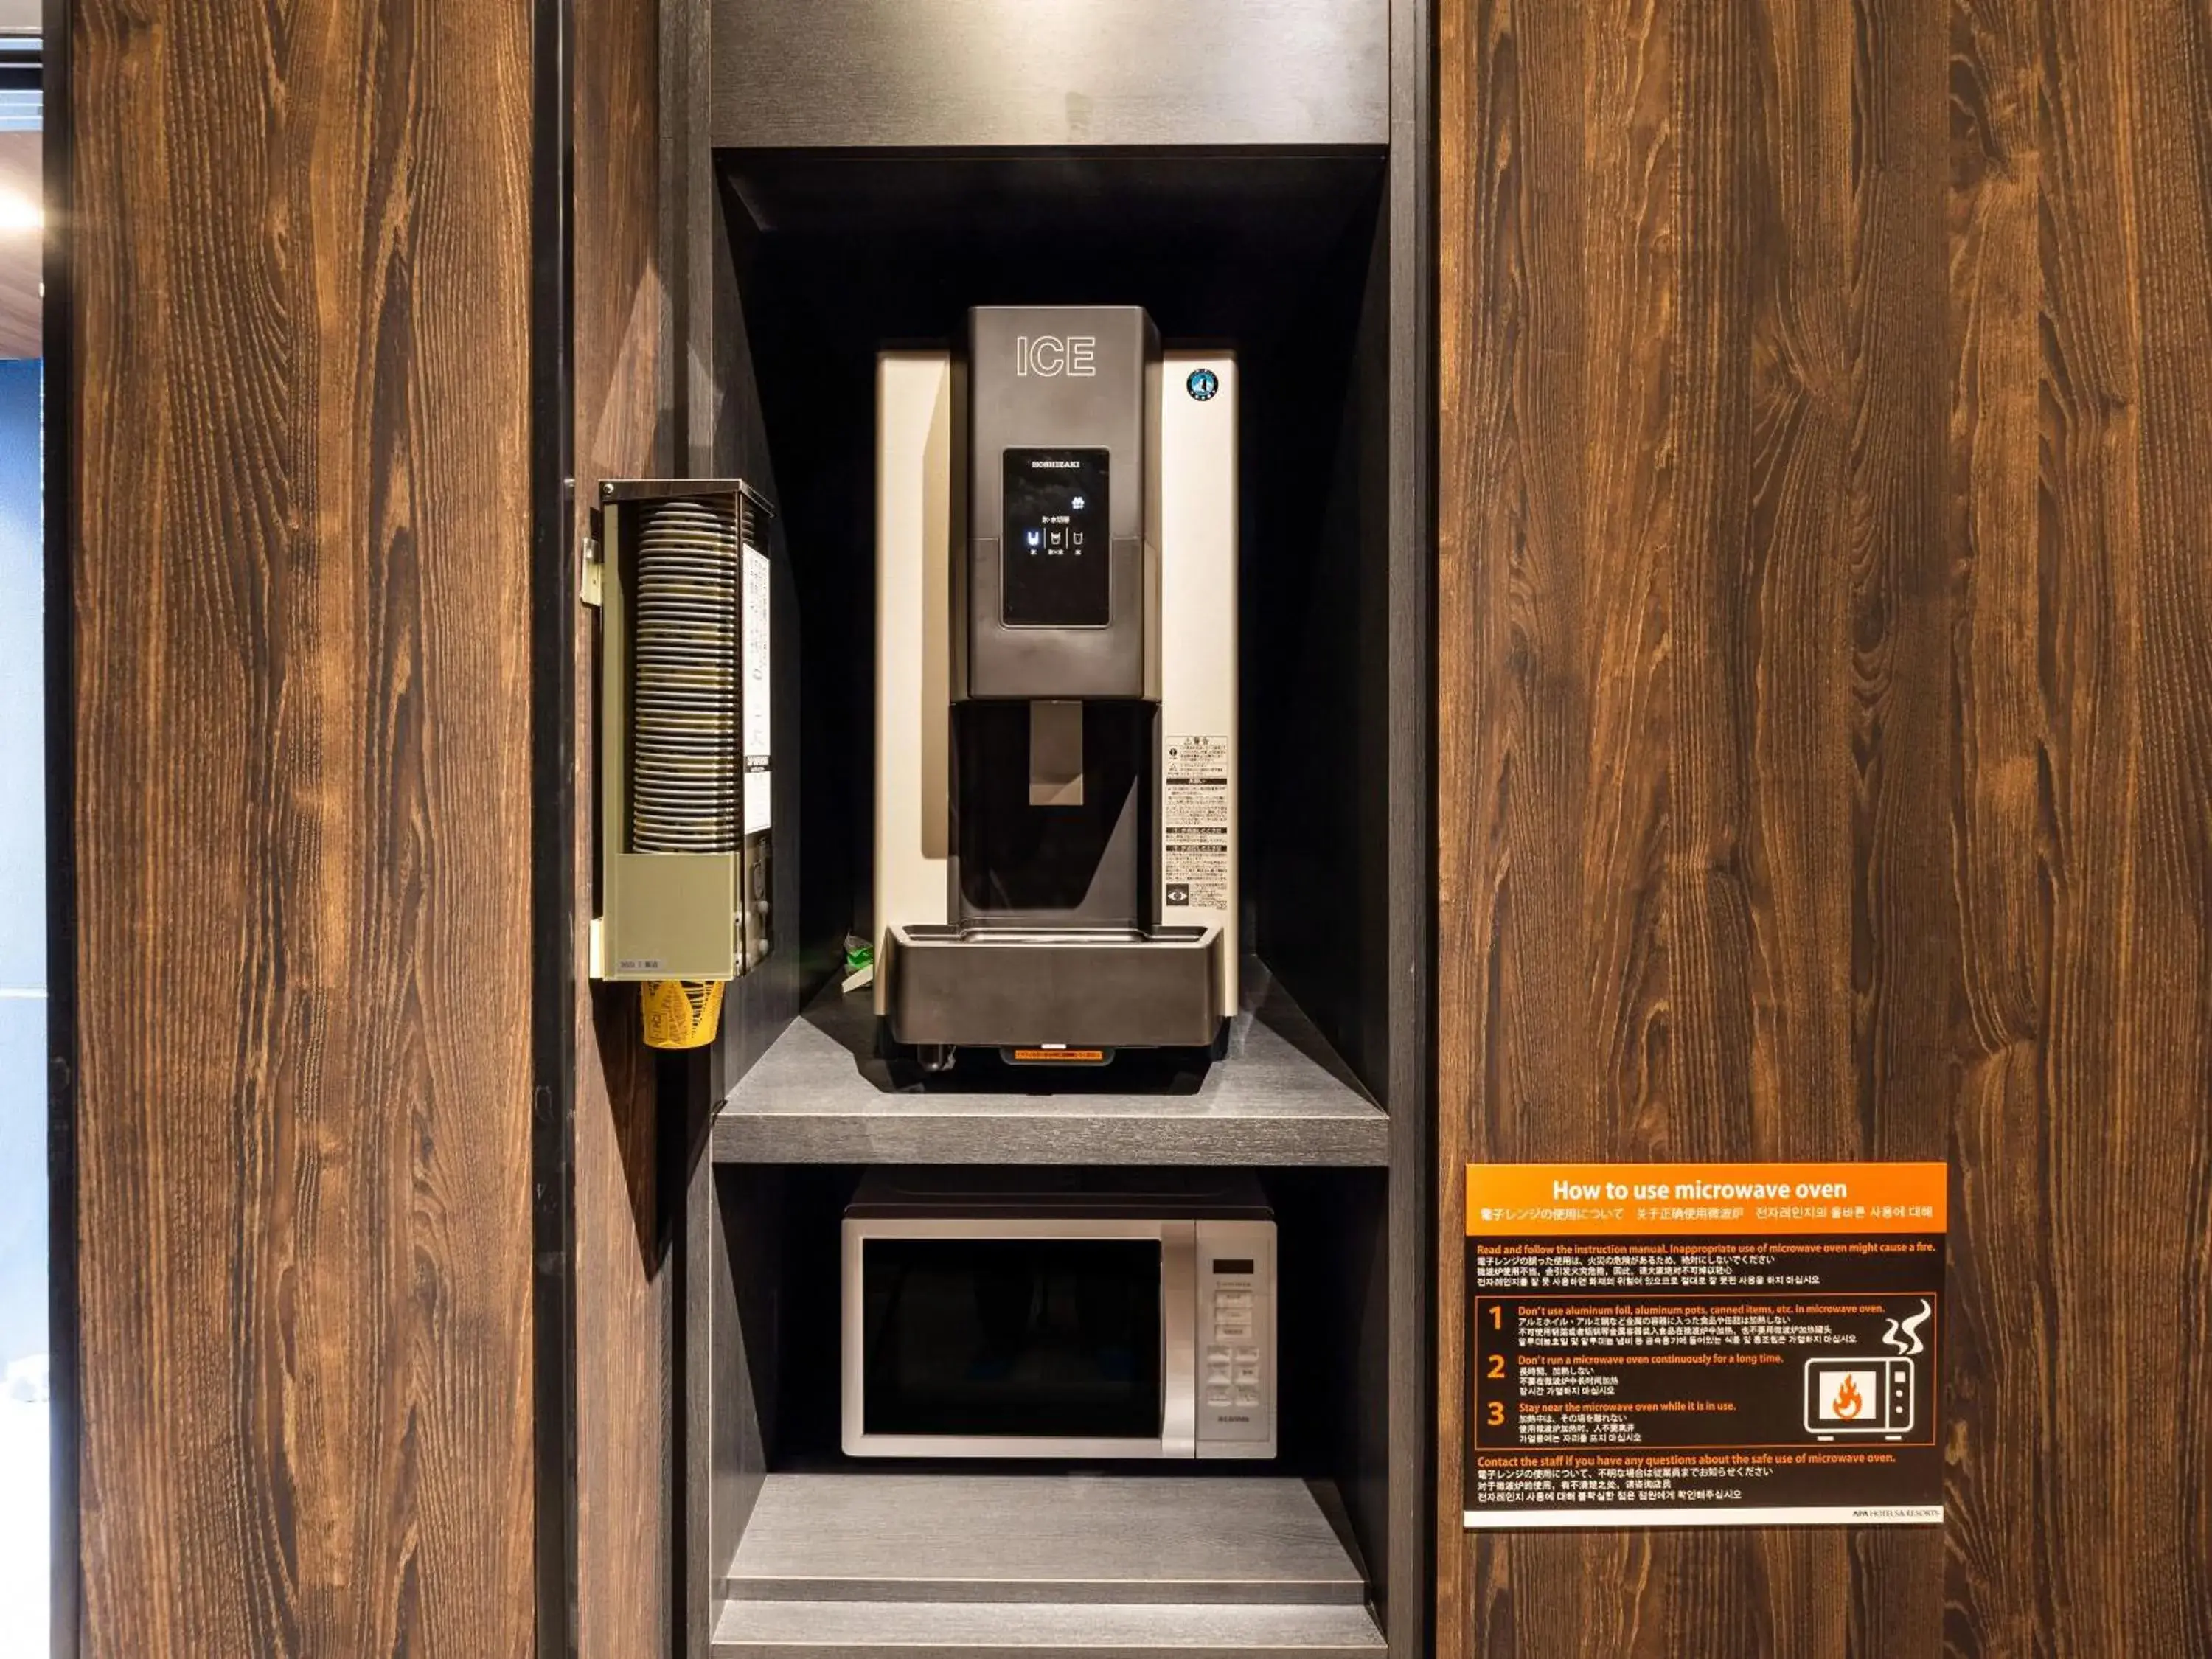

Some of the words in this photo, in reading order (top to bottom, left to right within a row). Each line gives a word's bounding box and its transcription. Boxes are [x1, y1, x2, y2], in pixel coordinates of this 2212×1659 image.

[1016, 335, 1096, 376] ICE
[1554, 1180, 1601, 1200] How
[1606, 1181, 1628, 1199] to
[1634, 1184, 1669, 1200] use
[1675, 1180, 1790, 1200] microwave
[1795, 1183, 1846, 1199] oven
[1481, 1208, 1623, 1221] 電子レンジの使用について
[1478, 1245, 1501, 1254] Read
[1503, 1245, 1522, 1254] and
[1524, 1245, 1554, 1254] follow
[1556, 1244, 1573, 1254] the
[1574, 1244, 1627, 1253] instruction
[1670, 1244, 1736, 1256] Inappropriate
[1738, 1245, 1756, 1253] use
[1756, 1243, 1767, 1253] of
[1769, 1243, 1823, 1253] microwave
[1848, 1243, 1879, 1255] might
[1489, 1306, 1501, 1329] 1
[1519, 1306, 1545, 1315] Don't
[1565, 1305, 1613, 1315] aluminum
[1635, 1305, 1683, 1315] aluminum
[1710, 1305, 1745, 1315] canned
[1795, 1304, 1805, 1314] in
[1806, 1304, 1857, 1314] microwave
[1487, 1354, 1505, 1378] 2
[1519, 1355, 1545, 1365] Don't
[1573, 1354, 1625, 1365] microwave
[1651, 1354, 1711, 1366] continuously
[1713, 1354, 1727, 1363] for
[1736, 1354, 1758, 1366] long
[1487, 1402, 1505, 1425] 3
[1520, 1403, 1540, 1415] Stay
[1565, 1402, 1581, 1412] the
[1582, 1402, 1634, 1412] microwave
[1660, 1402, 1686, 1411] while
[1688, 1402, 1695, 1411] it
[1697, 1402, 1704, 1411] is
[1705, 1402, 1716, 1411] in
[1478, 1456, 1518, 1467] Contact
[1520, 1456, 1539, 1467] the
[1540, 1456, 1564, 1467] staff
[1566, 1456, 1573, 1467] if
[1575, 1458, 1595, 1469] you
[1596, 1455, 1623, 1466] have
[1624, 1458, 1644, 1468] any
[1645, 1455, 1697, 1468] questions
[1698, 1455, 1730, 1465] about
[1731, 1455, 1750, 1465] the
[1751, 1454, 1773, 1465] safe
[1775, 1456, 1793, 1464] use
[1795, 1454, 1806, 1464] of
[1808, 1453, 1865, 1464] microwave
